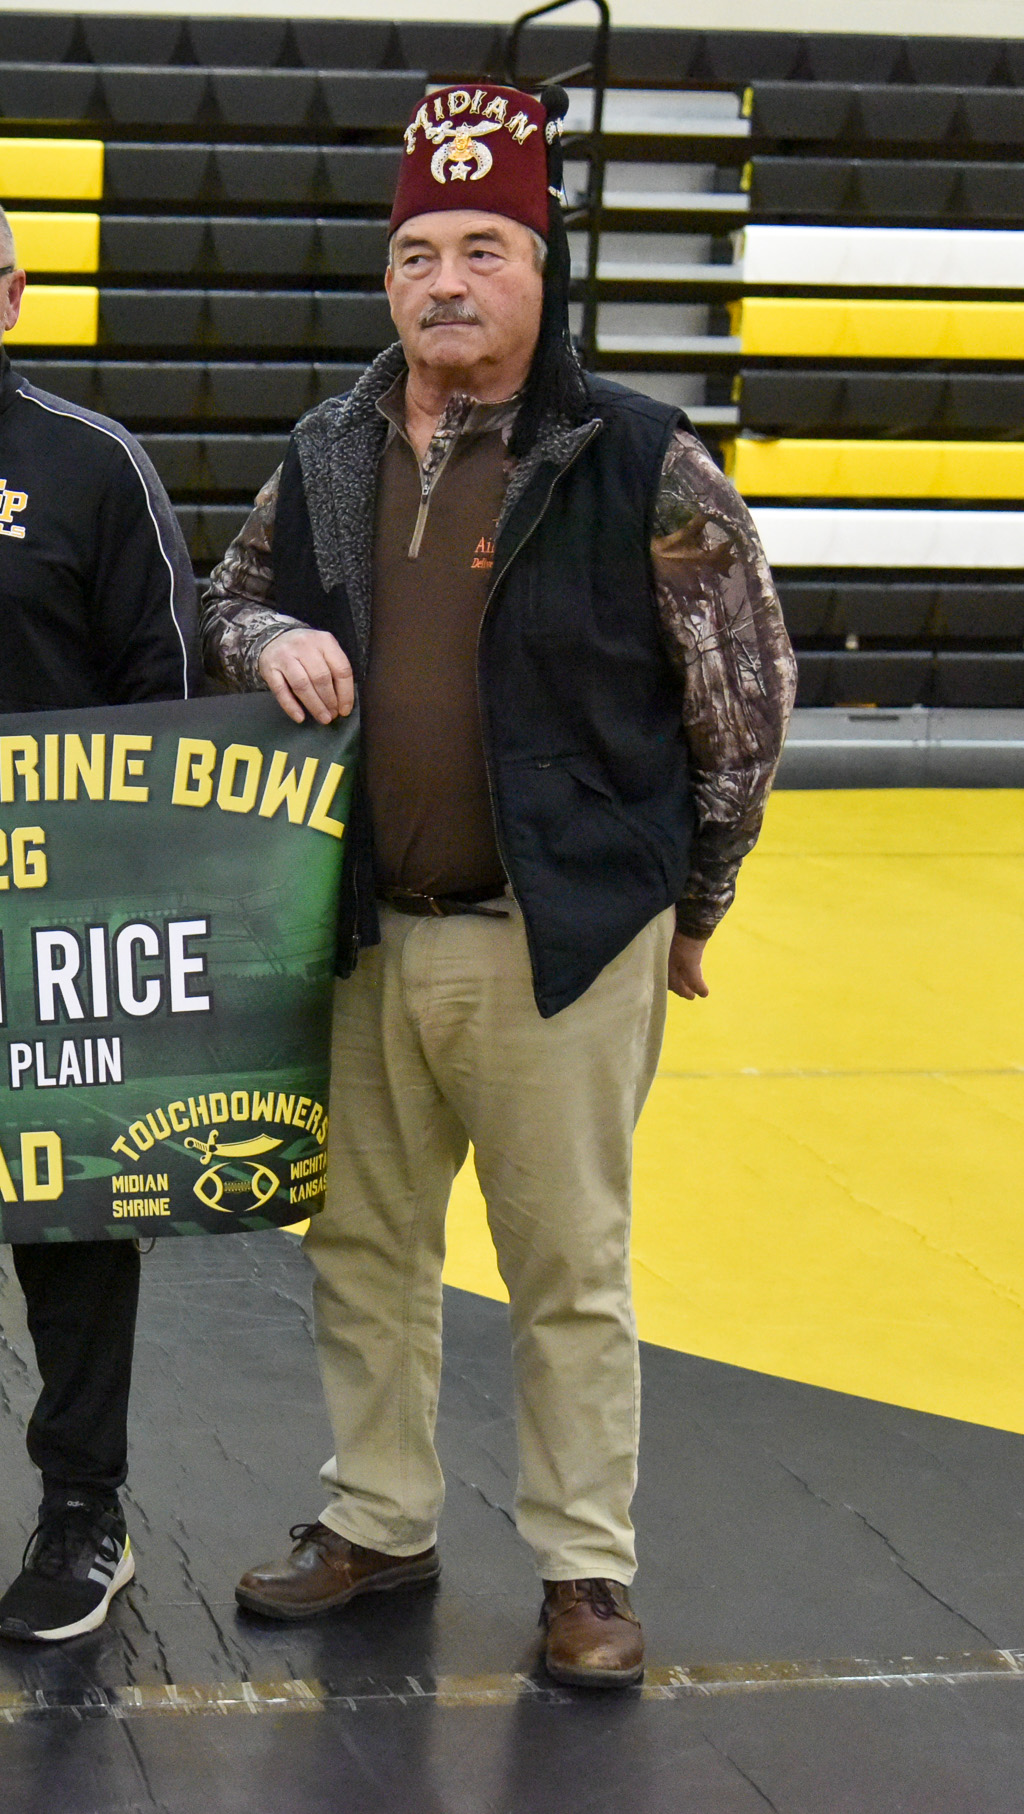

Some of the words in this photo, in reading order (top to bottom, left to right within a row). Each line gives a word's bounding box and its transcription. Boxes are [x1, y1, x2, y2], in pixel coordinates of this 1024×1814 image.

[404, 89, 538, 155] MIDIAN
[171, 737, 345, 839] BOWL
[35, 919, 210, 1022] RICE
[10, 1036, 123, 1089] PLAIN
[111, 1090, 329, 1162] TOUCHDOWNERS
[112, 1173, 169, 1194] MIDIAN
[112, 1198, 171, 1218] SHRINE
